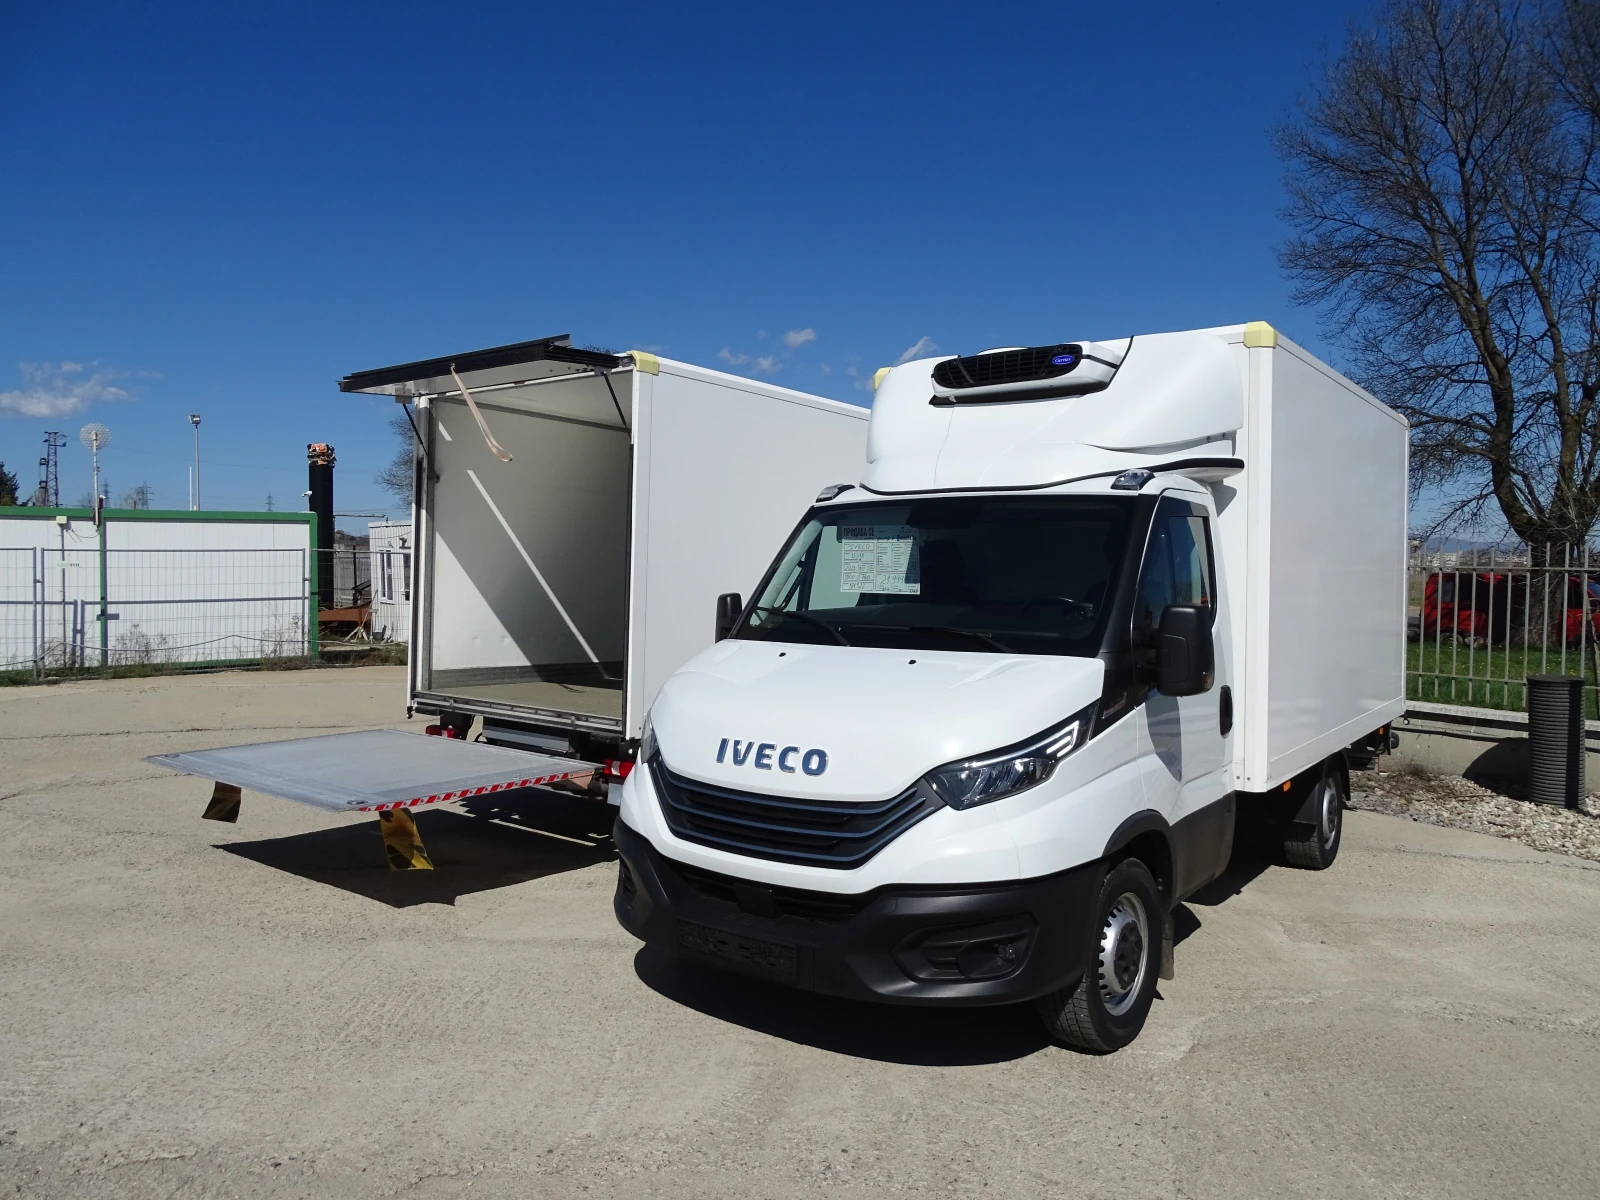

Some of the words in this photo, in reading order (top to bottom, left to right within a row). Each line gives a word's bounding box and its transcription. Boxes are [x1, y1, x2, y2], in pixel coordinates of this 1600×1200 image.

[843, 527, 867, 537] ПРОДАВА
[868, 527, 875, 536] СЕ
[716, 737, 829, 777] IVECO
